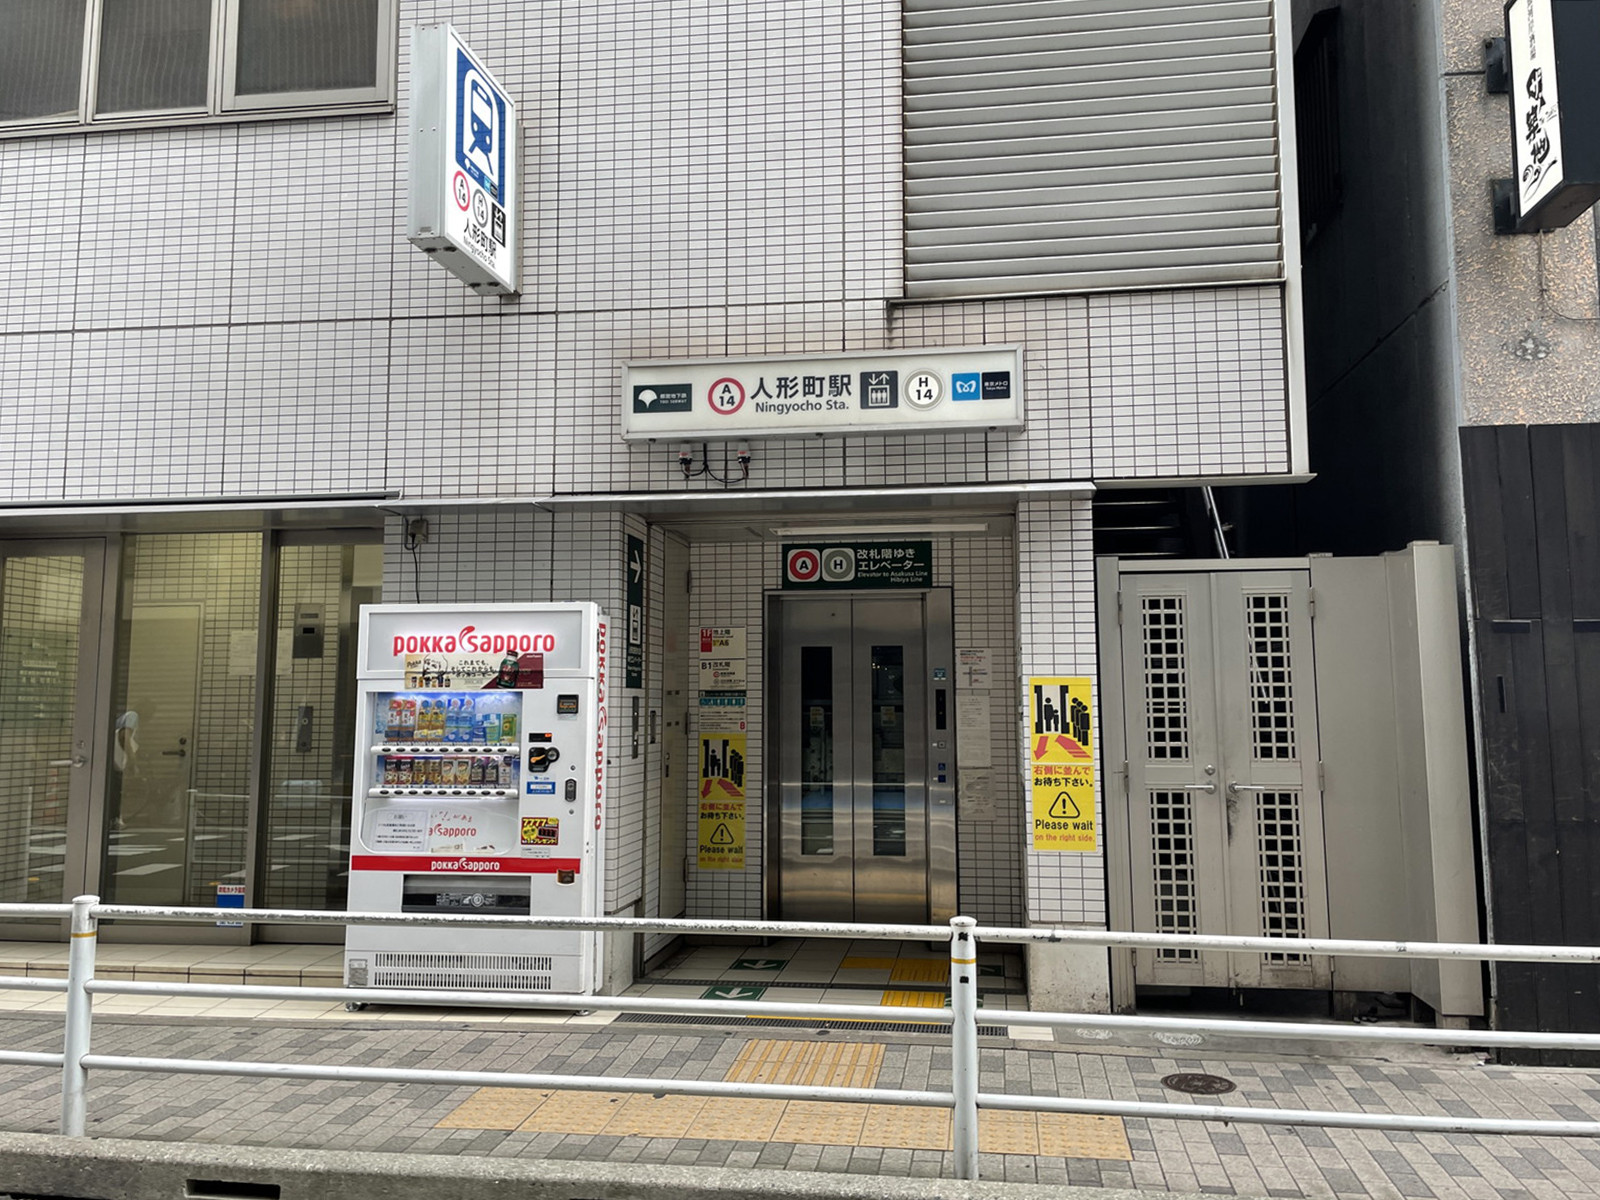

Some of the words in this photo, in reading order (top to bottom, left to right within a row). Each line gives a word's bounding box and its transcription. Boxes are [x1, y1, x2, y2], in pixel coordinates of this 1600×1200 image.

[463, 217, 497, 260] 人形町駅
[750, 374, 852, 401] 人形町駅
[918, 377, 929, 388] H
[721, 383, 732, 395] A
[915, 389, 933, 401] 14
[718, 395, 736, 408] 14
[754, 401, 823, 415] Ningyocho
[825, 398, 850, 411] Sta.
[857, 549, 915, 560] 改札階ゆき
[798, 560, 809, 571] A
[833, 559, 843, 570] H
[858, 560, 925, 571] エレベーター
[701, 662, 712, 670] B1
[1034, 766, 1090, 776] 右側に並んで
[1035, 777, 1093, 787] お待ち下さい。
[522, 818, 547, 827] 7777
[1036, 819, 1068, 830] Please
[1073, 820, 1093, 830] wait
[1060, 834, 1075, 842] right
[699, 844, 725, 854] Please
[727, 845, 744, 854] wait
[431, 859, 459, 871] pokka
